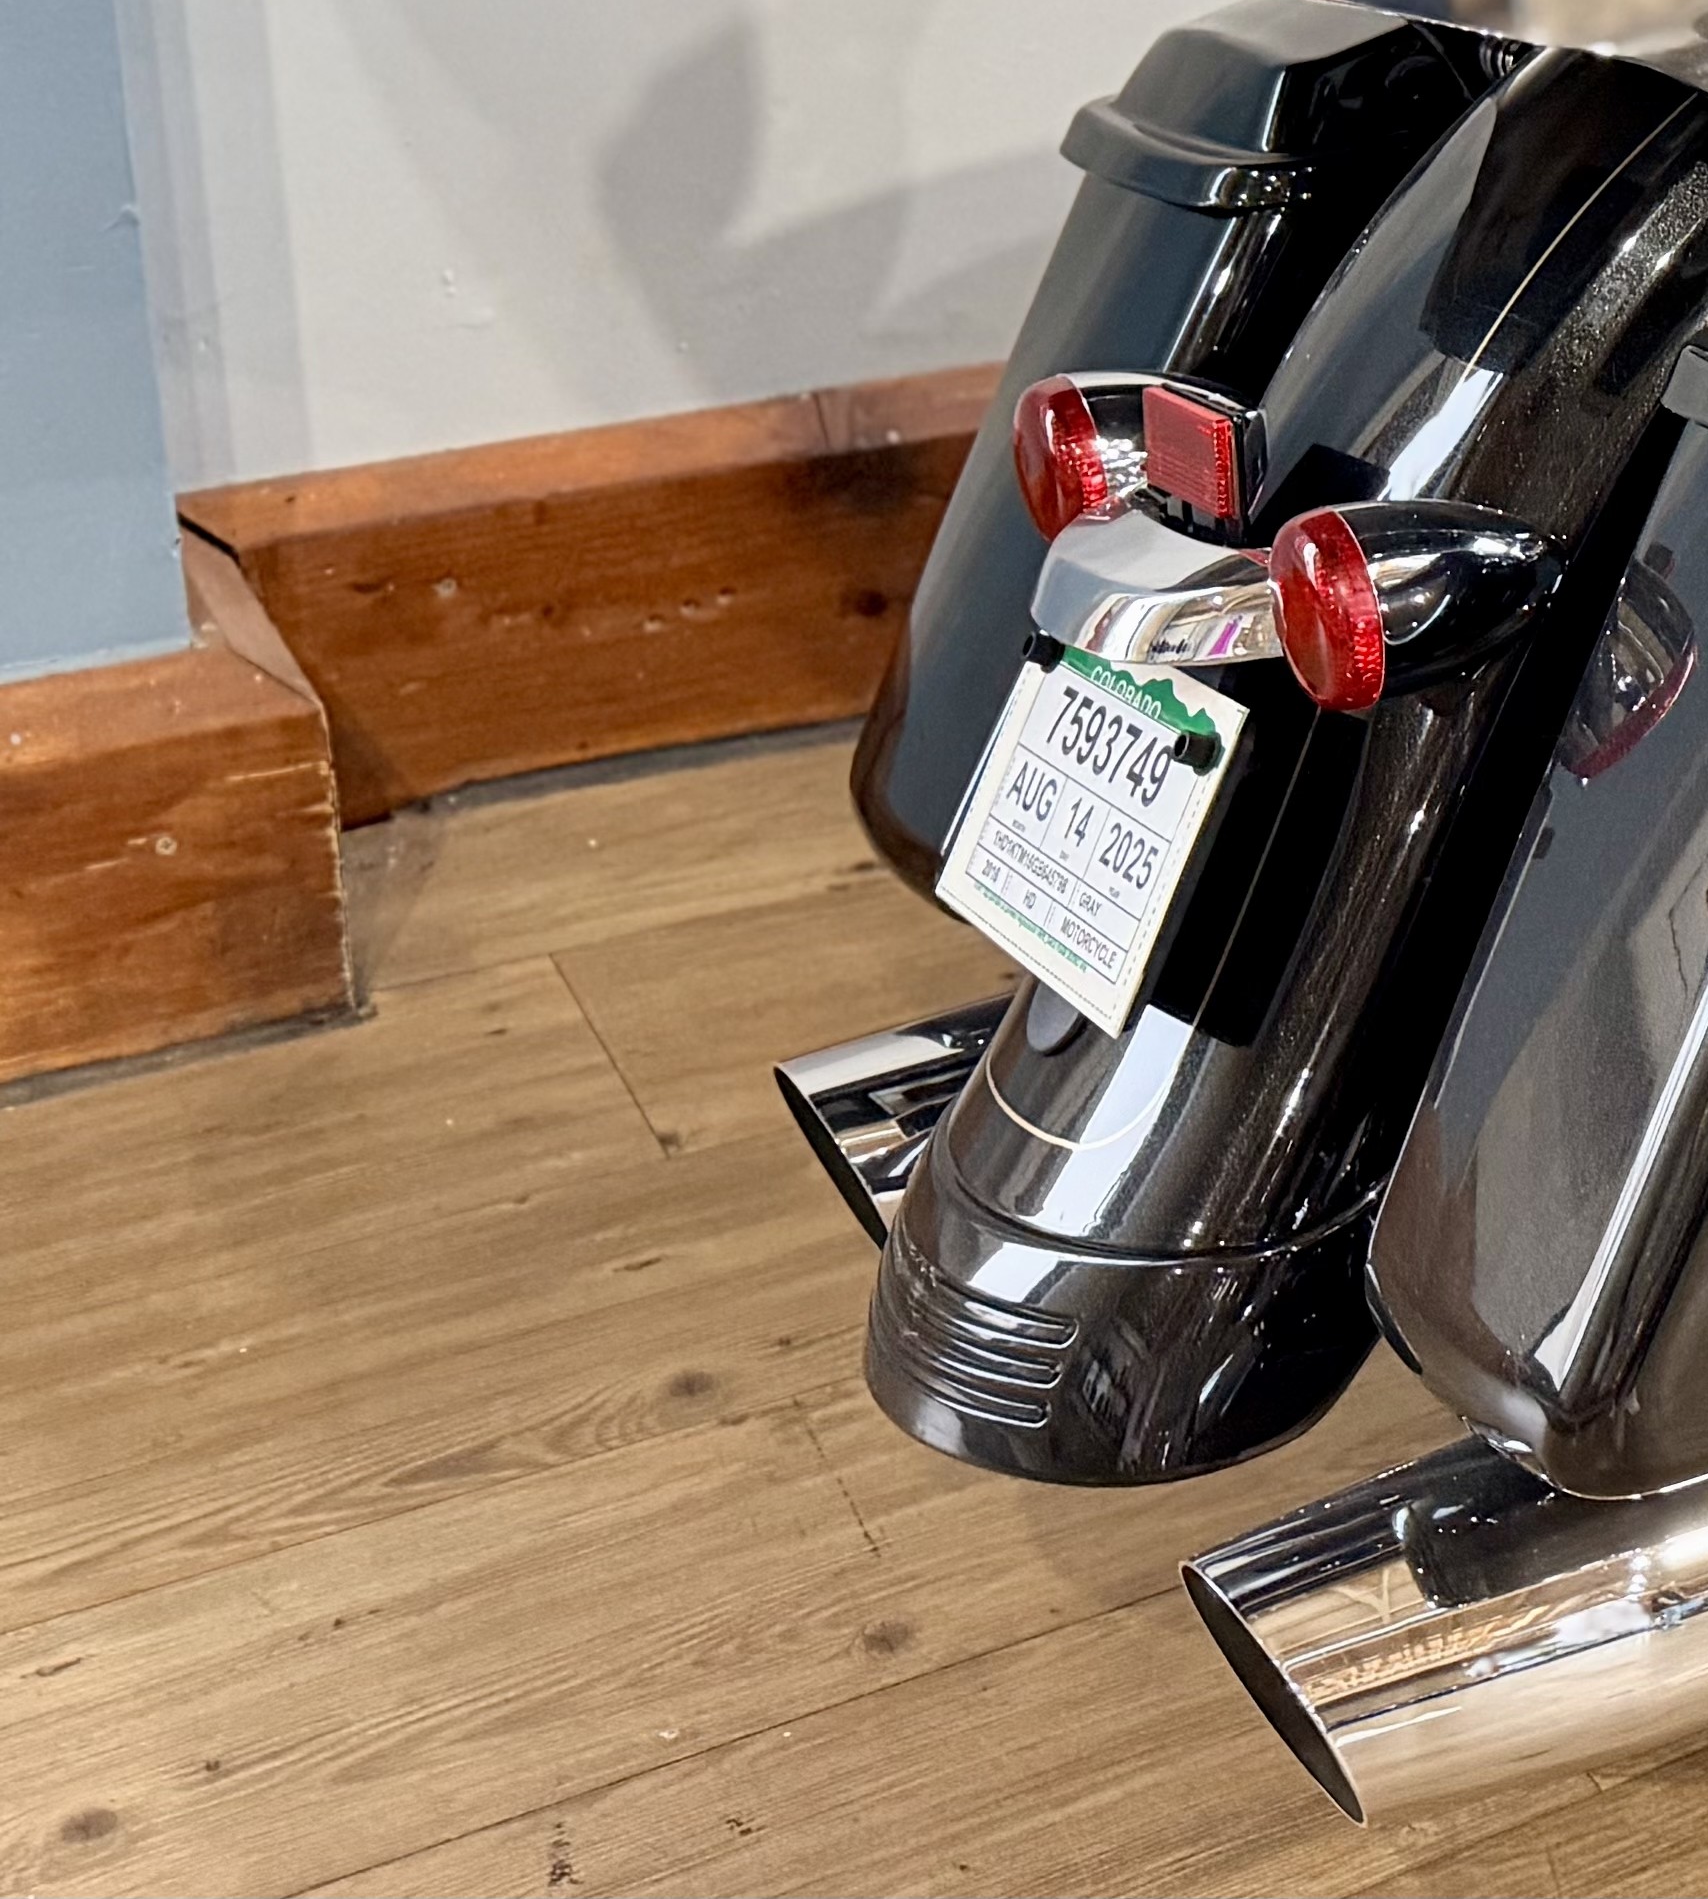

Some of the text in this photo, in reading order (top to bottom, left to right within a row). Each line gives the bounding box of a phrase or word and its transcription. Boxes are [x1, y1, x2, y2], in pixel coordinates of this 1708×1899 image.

[1090, 665, 1162, 719] COLORADO
[1046, 685, 1173, 807] 7593749
[1006, 761, 1159, 889] AUG 14 2025
[1023, 889, 1036, 909] HD
[1060, 916, 1117, 969] MOTORCYCLE
[1079, 892, 1102, 916] GRAY
